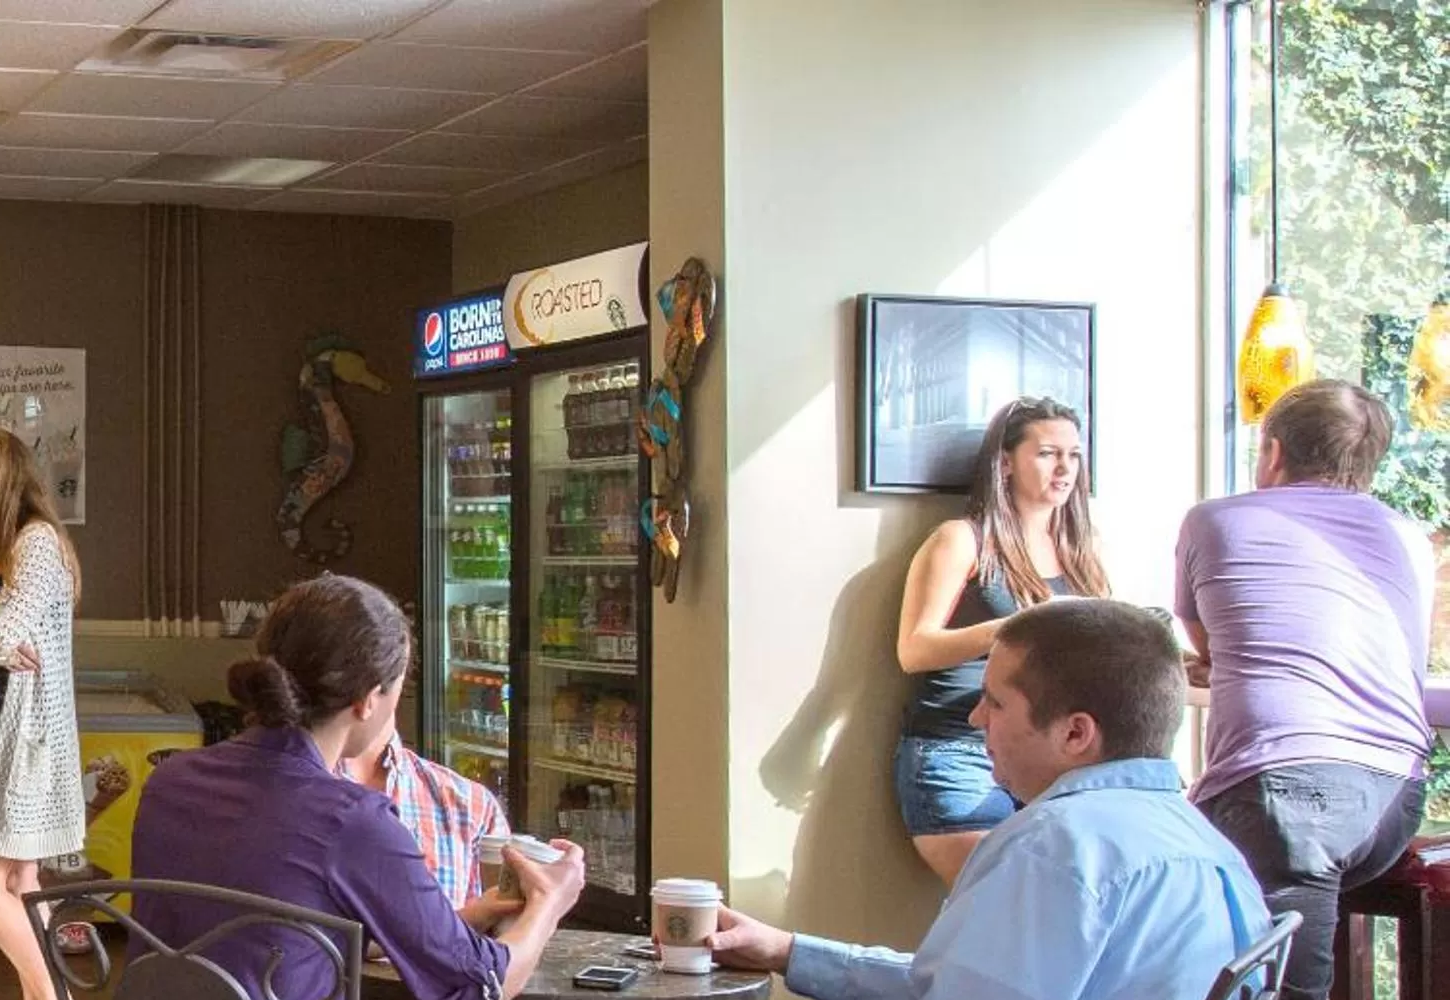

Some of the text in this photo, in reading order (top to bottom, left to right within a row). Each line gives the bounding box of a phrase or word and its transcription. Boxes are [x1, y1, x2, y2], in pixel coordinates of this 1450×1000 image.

[531, 278, 603, 320] ROASTED
[449, 302, 490, 333] BORN
[449, 324, 505, 352] CAROLINAS
